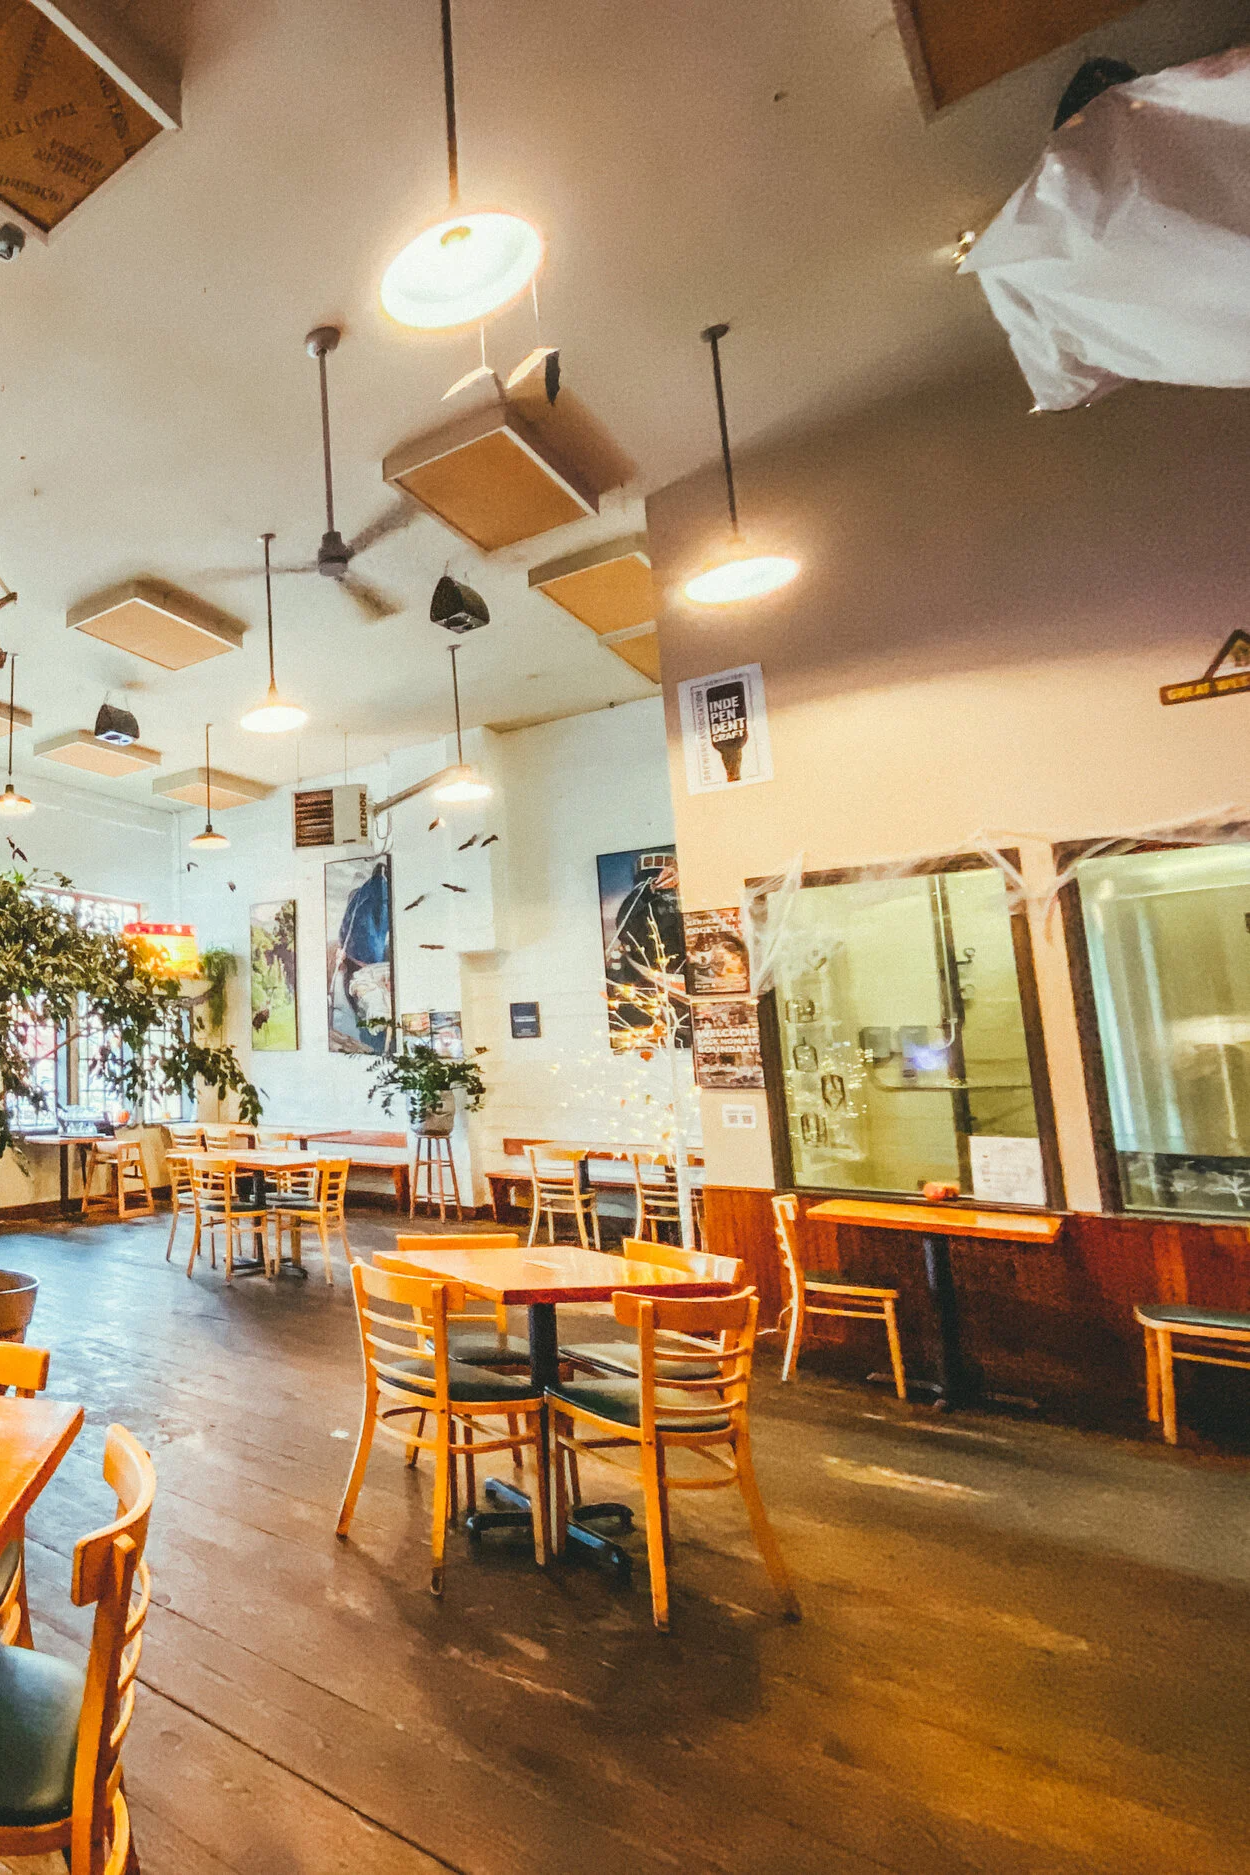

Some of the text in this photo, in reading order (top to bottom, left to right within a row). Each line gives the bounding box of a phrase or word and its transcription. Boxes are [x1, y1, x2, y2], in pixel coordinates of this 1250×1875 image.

[709, 695, 739, 713] INDE
[710, 708, 736, 724] PEN
[711, 717, 746, 735] DENT
[712, 729, 744, 743] CRAFT
[695, 1028, 759, 1038] WELCOME
[747, 1036, 759, 1044] TO
